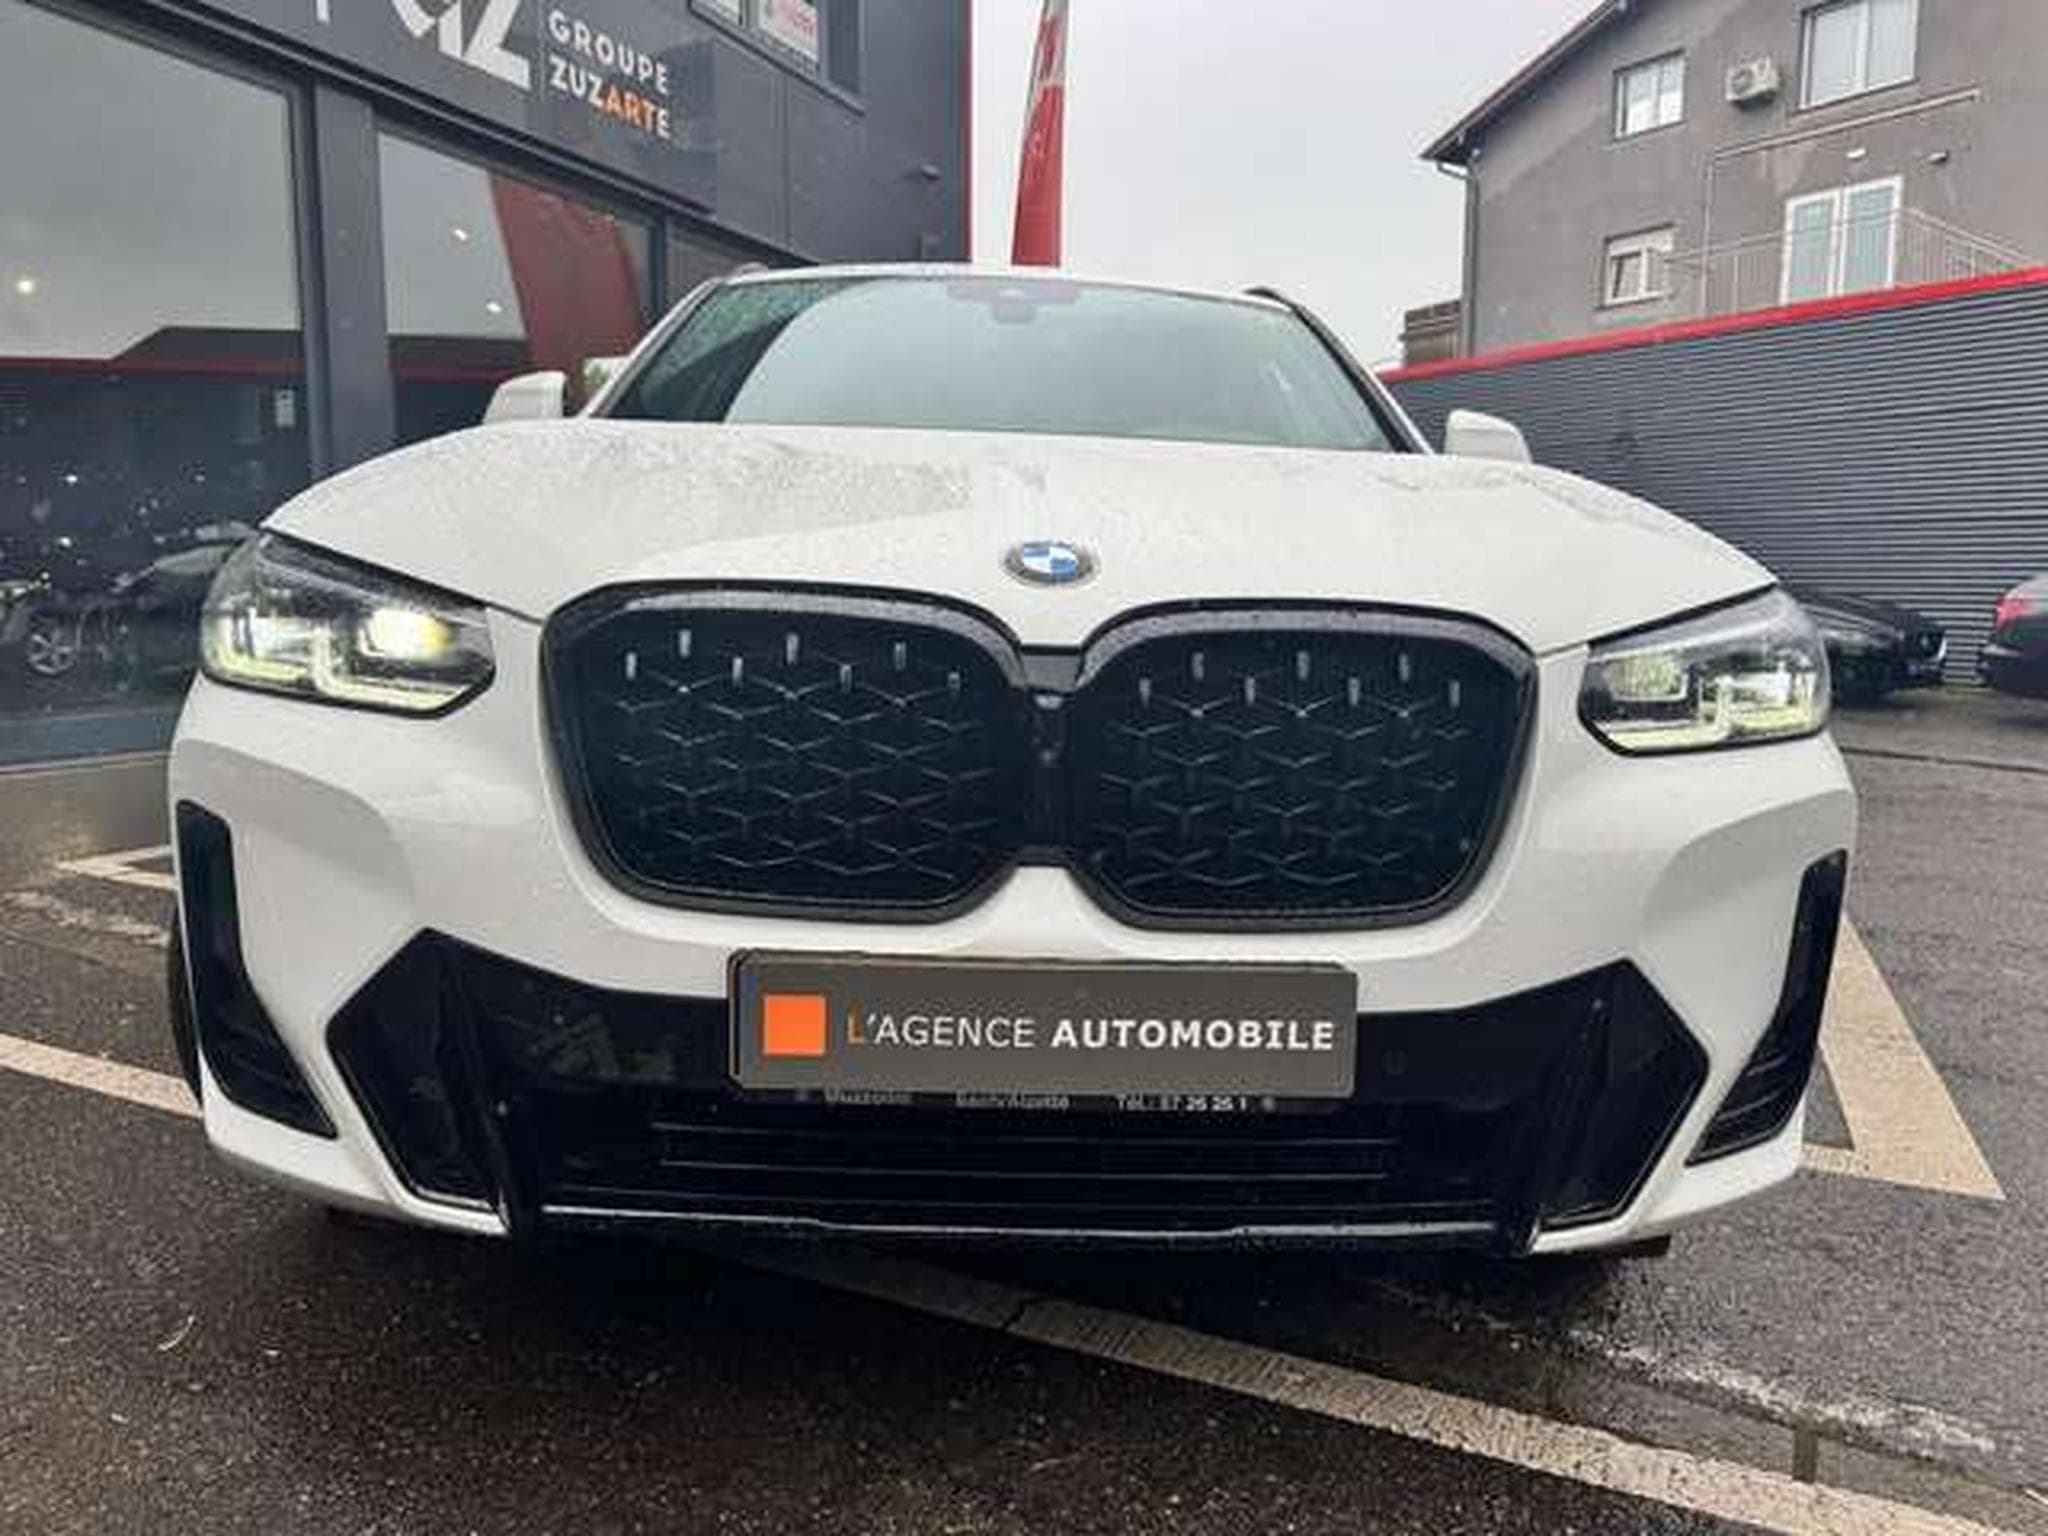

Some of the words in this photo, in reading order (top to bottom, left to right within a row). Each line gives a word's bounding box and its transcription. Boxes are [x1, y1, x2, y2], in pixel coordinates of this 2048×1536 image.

[548, 9, 668, 95] GROUPE
[549, 54, 671, 138] ZUZARTE
[846, 1013, 1035, 1048] L'AGENCE
[1051, 1019, 1335, 1050] AUTOMOBILE
